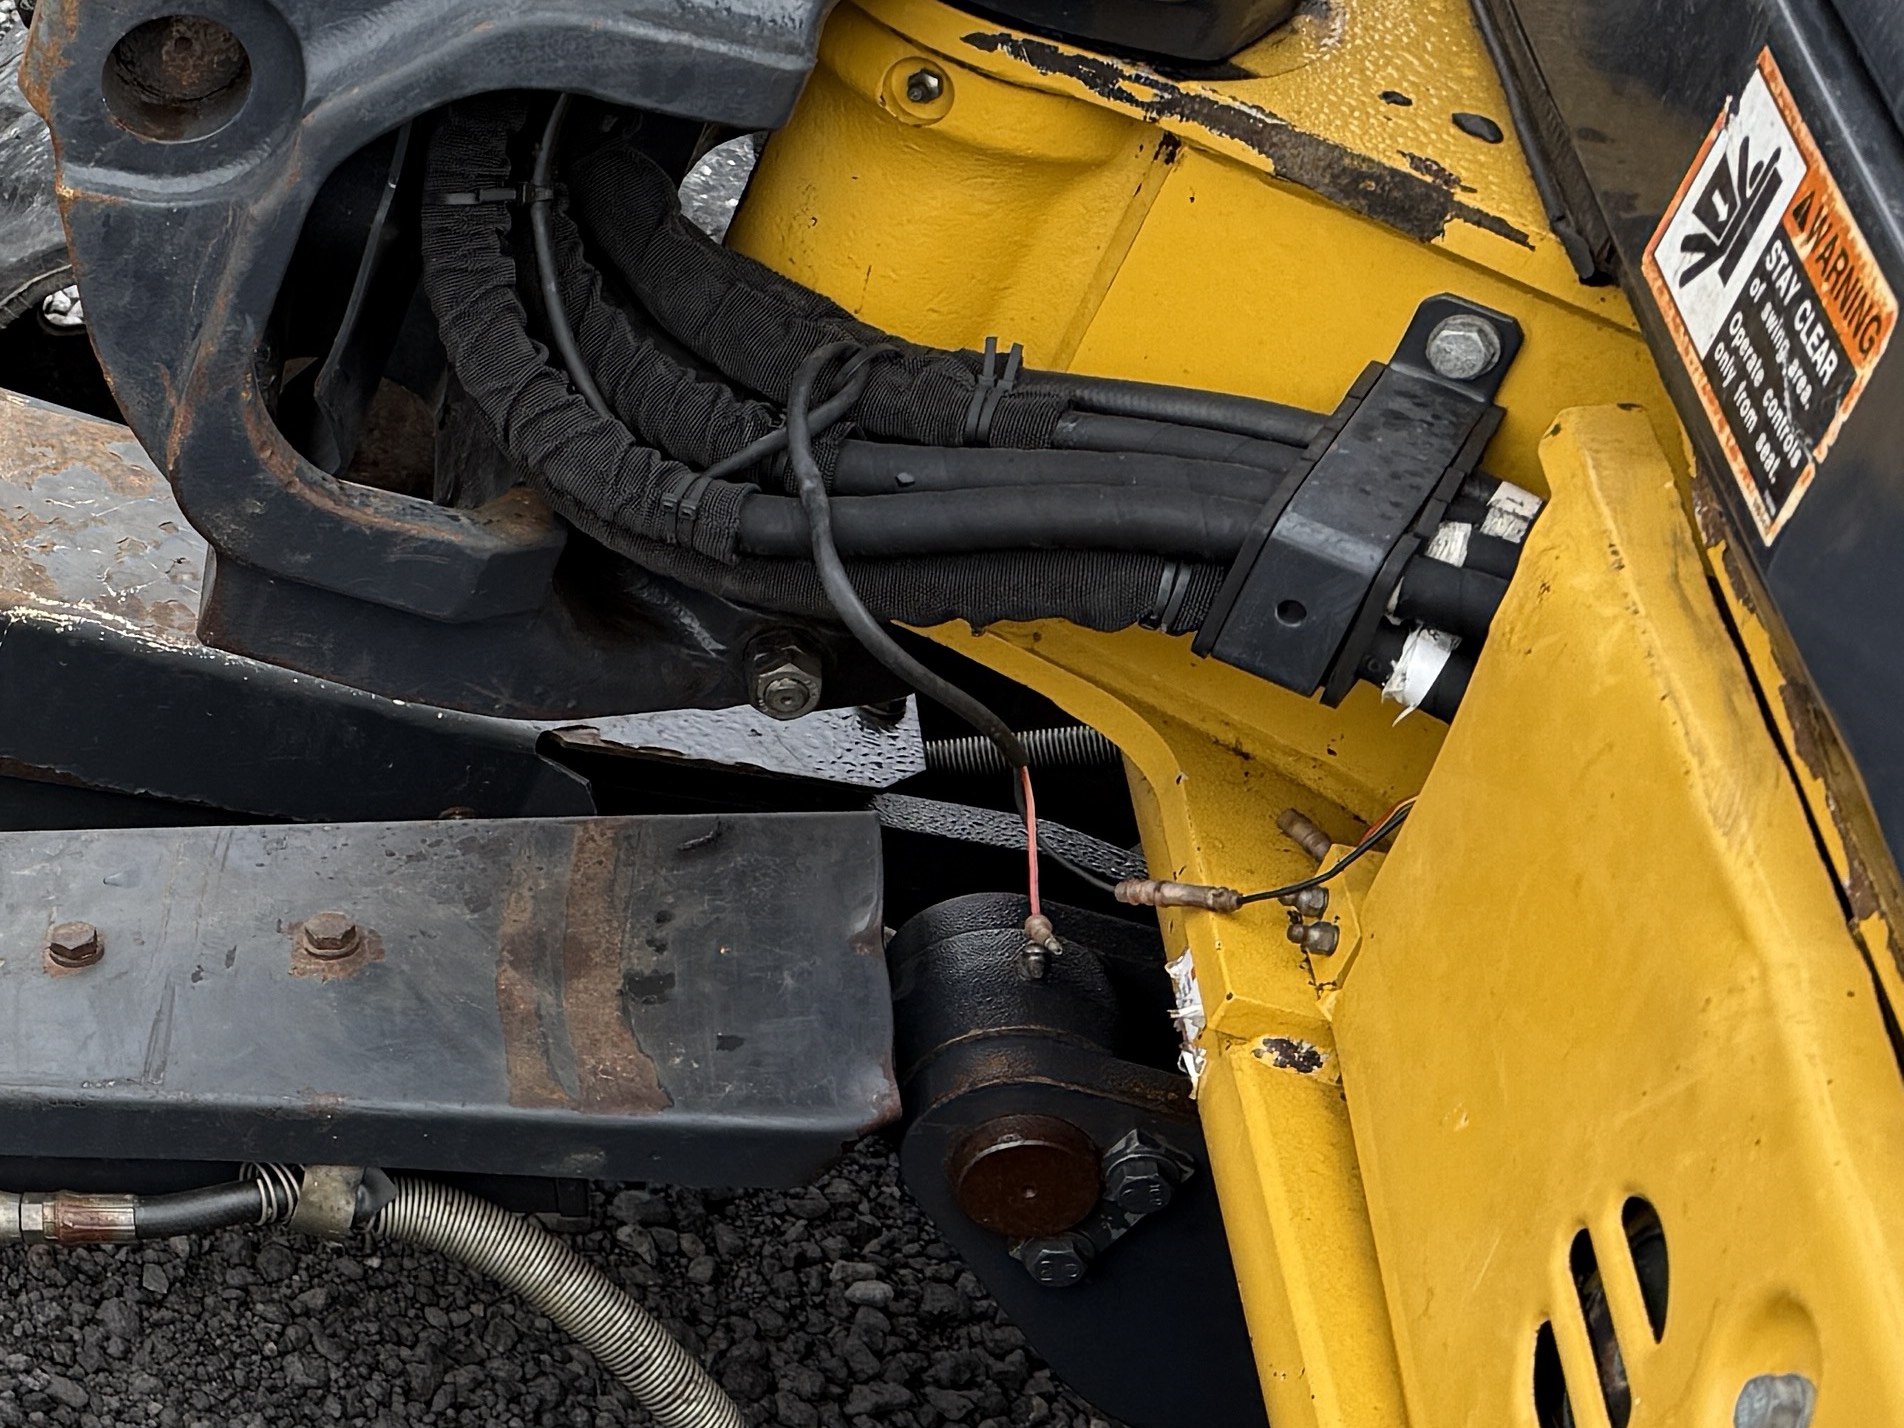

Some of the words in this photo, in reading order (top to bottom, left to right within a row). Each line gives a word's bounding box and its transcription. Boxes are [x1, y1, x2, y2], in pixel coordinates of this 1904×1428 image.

[1749, 276, 1766, 304] of
[1759, 304, 1791, 364] swing
[1788, 359, 1813, 411] area.
[1764, 239, 1801, 307] STAY
[1793, 298, 1839, 387] CLEAR
[1805, 206, 1881, 360] WARNING
[1713, 341, 1737, 389] only
[1733, 380, 1759, 434] from
[1755, 431, 1782, 484] seat.
[1728, 310, 1766, 388] Operate
[1762, 387, 1803, 470] controls
